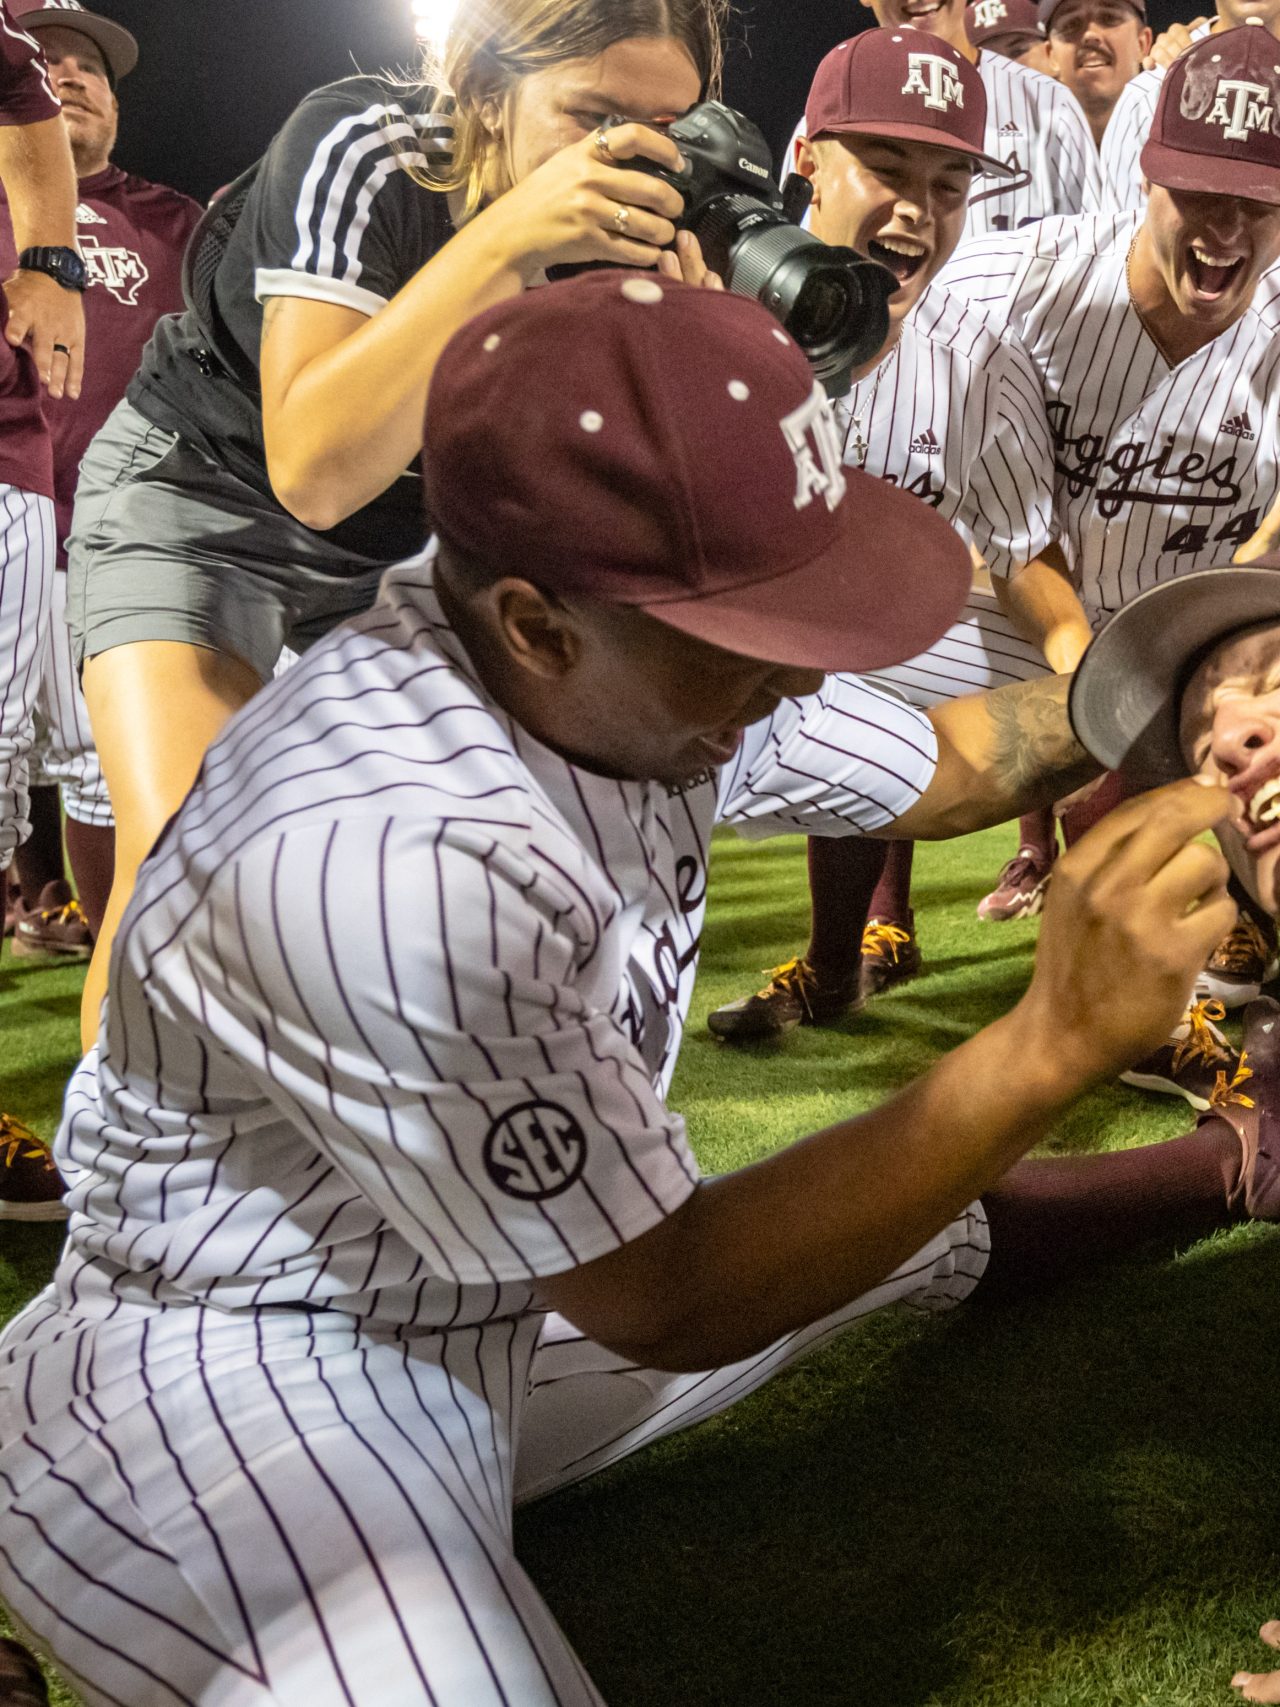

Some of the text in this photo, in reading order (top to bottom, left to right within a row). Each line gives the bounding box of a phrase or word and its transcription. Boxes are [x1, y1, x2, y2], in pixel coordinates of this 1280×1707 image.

[738, 157, 769, 179] Canon
[1219, 424, 1255, 441] adidas
[908, 443, 941, 455] adidas
[1161, 507, 1262, 555] 44
[667, 766, 716, 798] didas
[491, 1107, 579, 1192] SEC
